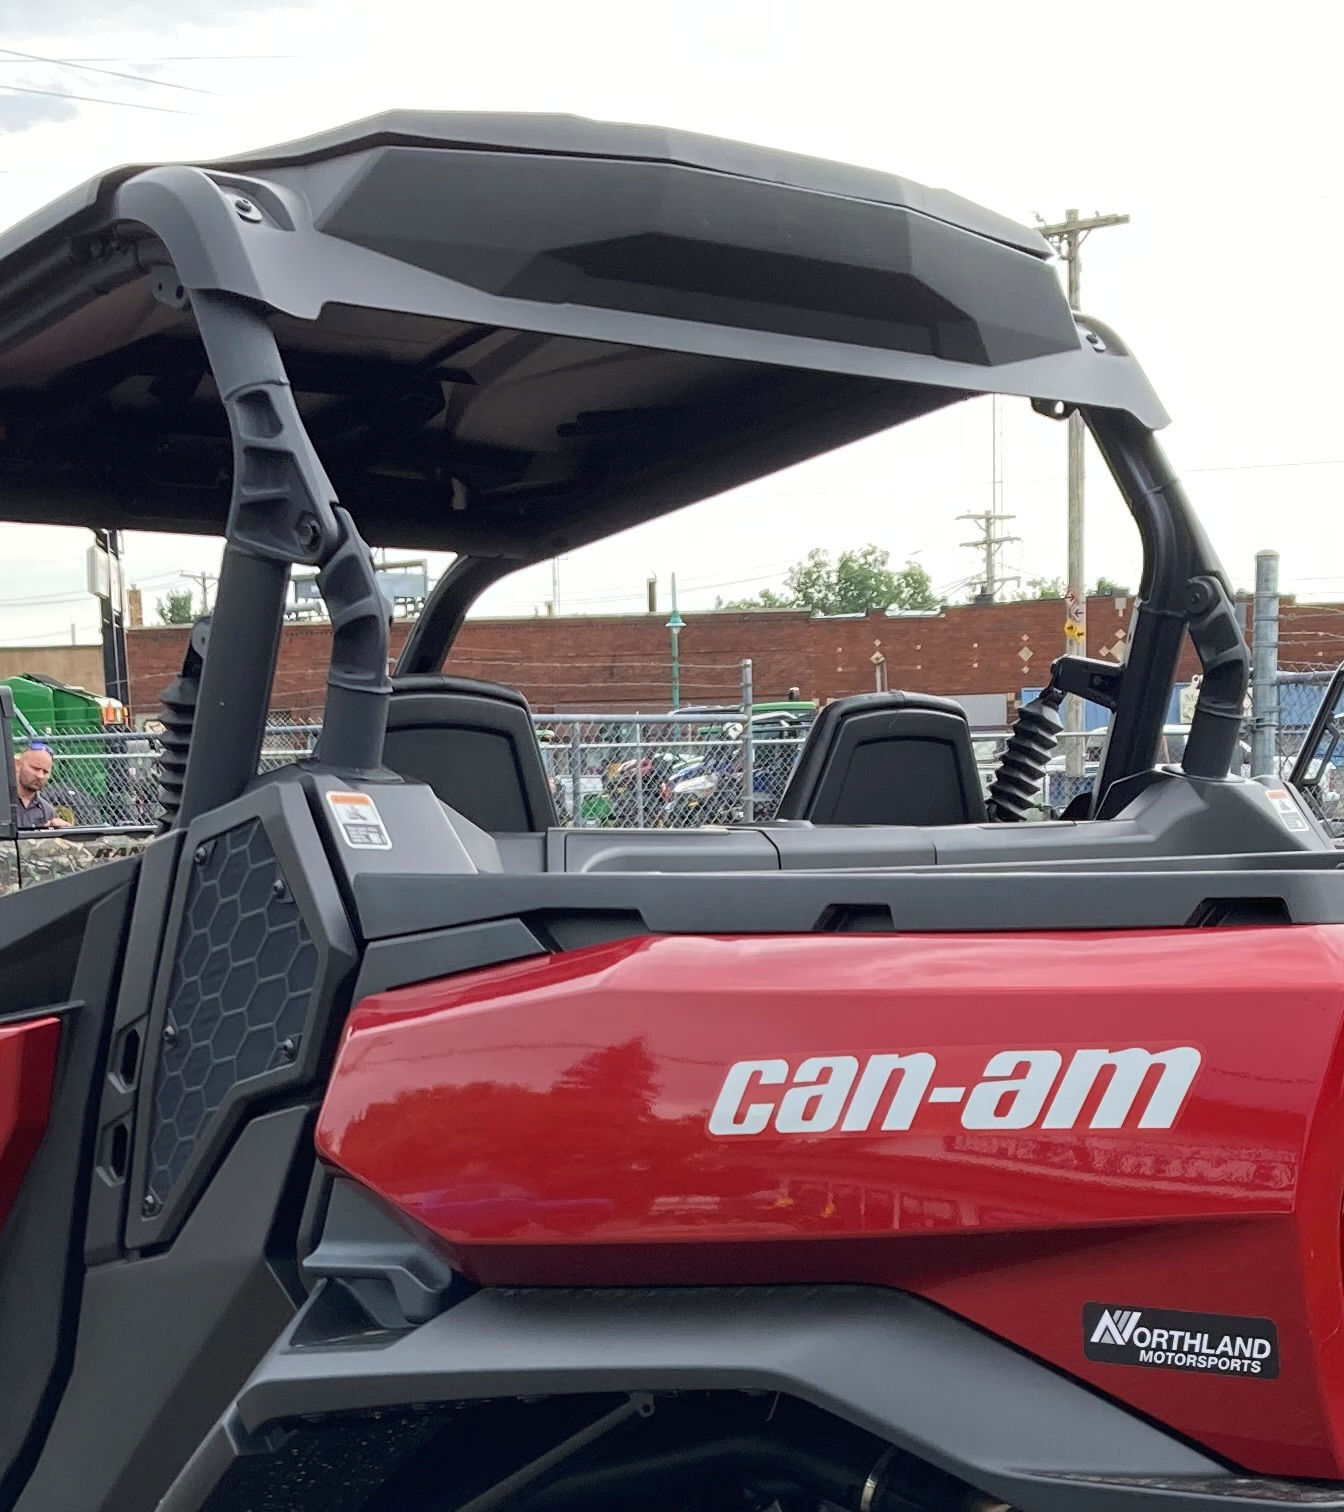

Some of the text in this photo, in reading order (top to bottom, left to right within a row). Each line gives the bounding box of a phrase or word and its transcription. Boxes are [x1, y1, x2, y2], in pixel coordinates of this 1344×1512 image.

[707, 1047, 1202, 1136] can-am
[1090, 1308, 1272, 1359] NORTHLAND
[1139, 1350, 1262, 1374] MOTORSPORTS
